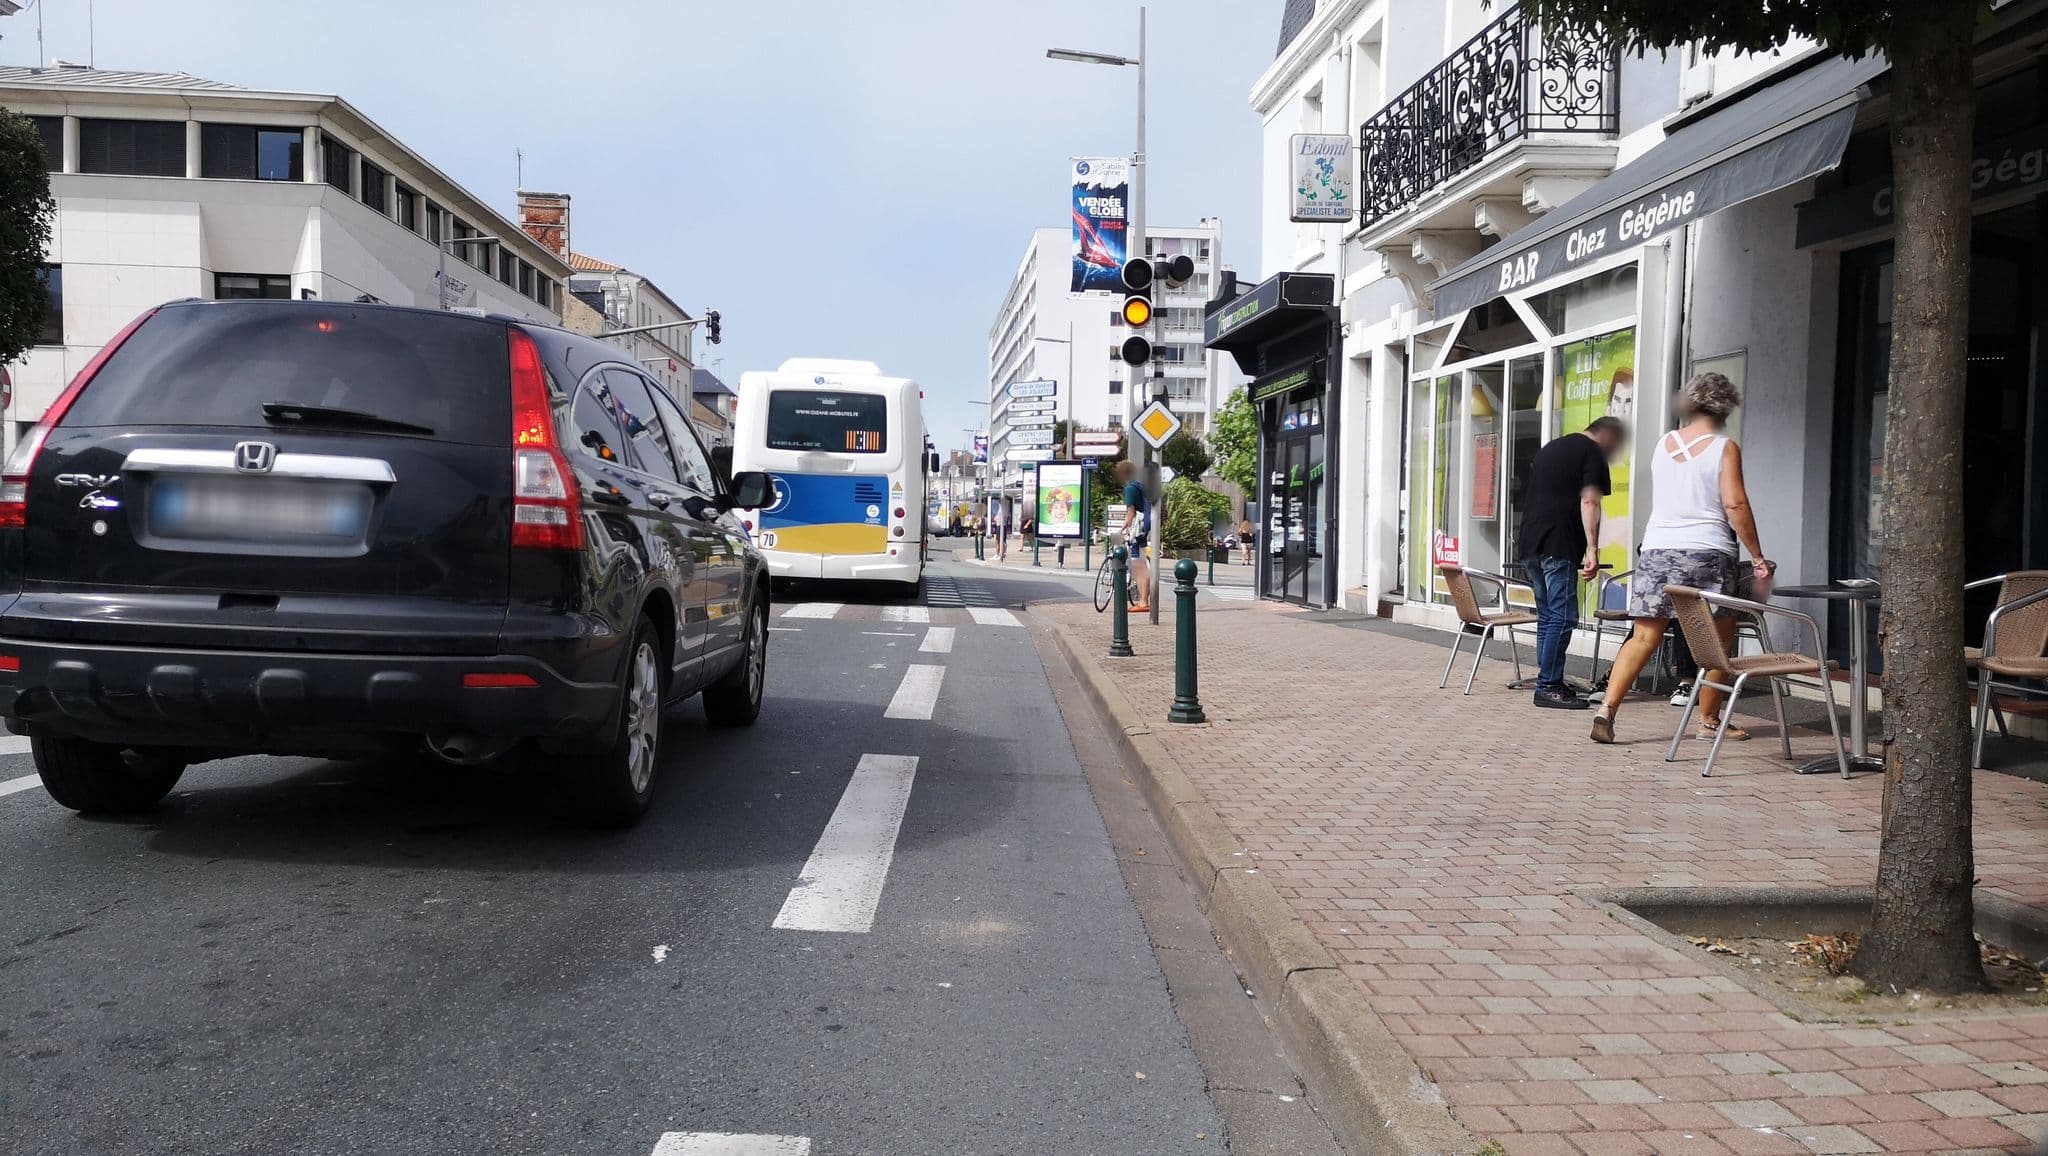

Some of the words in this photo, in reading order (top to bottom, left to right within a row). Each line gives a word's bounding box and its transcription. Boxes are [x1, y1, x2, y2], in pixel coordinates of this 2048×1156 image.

[1079, 195, 1121, 207] VENDÉE
[1089, 206, 1124, 216] GLOBE
[1498, 251, 1539, 292] BAR
[1566, 227, 1606, 261] Chez
[1618, 190, 1695, 241] Gégène
[1575, 351, 1602, 374] Luc
[1567, 377, 1609, 401] Coiffure
[54, 473, 120, 487] CR-V
[763, 533, 774, 547] 70
